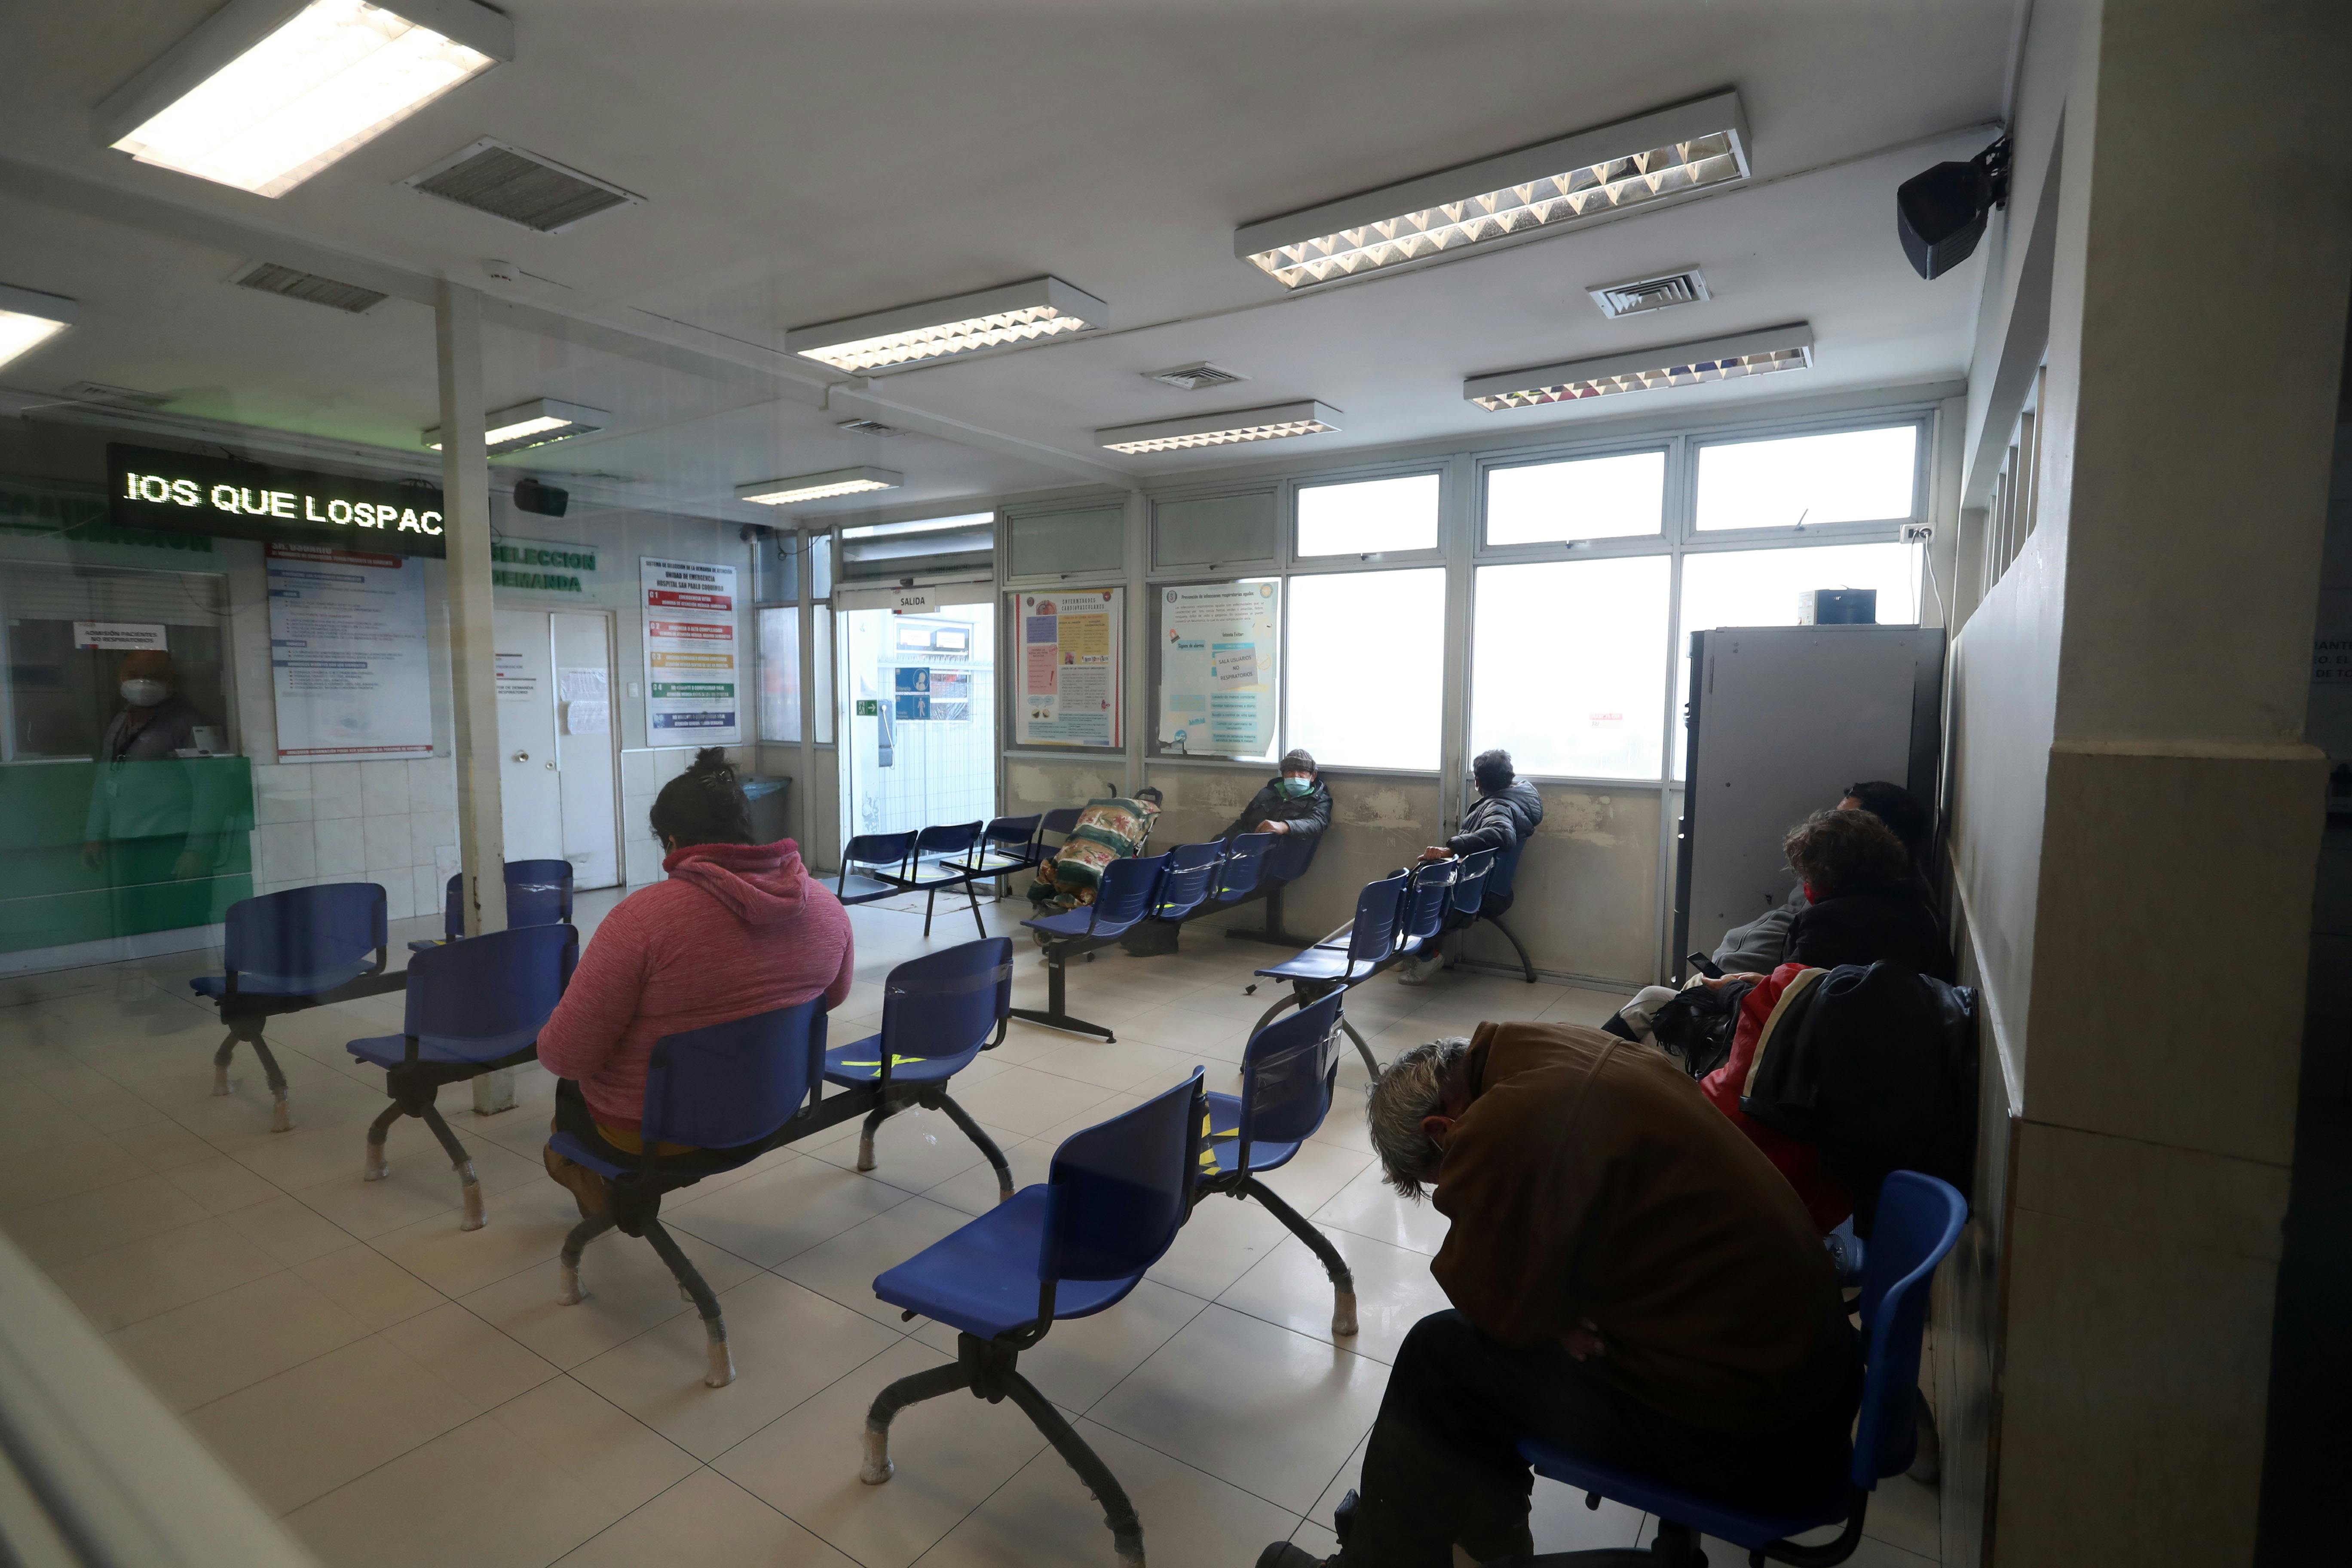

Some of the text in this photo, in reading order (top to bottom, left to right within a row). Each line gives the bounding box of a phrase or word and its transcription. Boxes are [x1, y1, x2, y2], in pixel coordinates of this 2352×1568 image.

[211, 484, 298, 519] QUE
[493, 570, 582, 592] DEMANDA
[689, 574, 715, 582] EMERGENCIA
[900, 597, 925, 606] SALIDA
[1220, 672, 1253, 680] RESPIRATORIOS
[2315, 670, 2332, 678] DE
